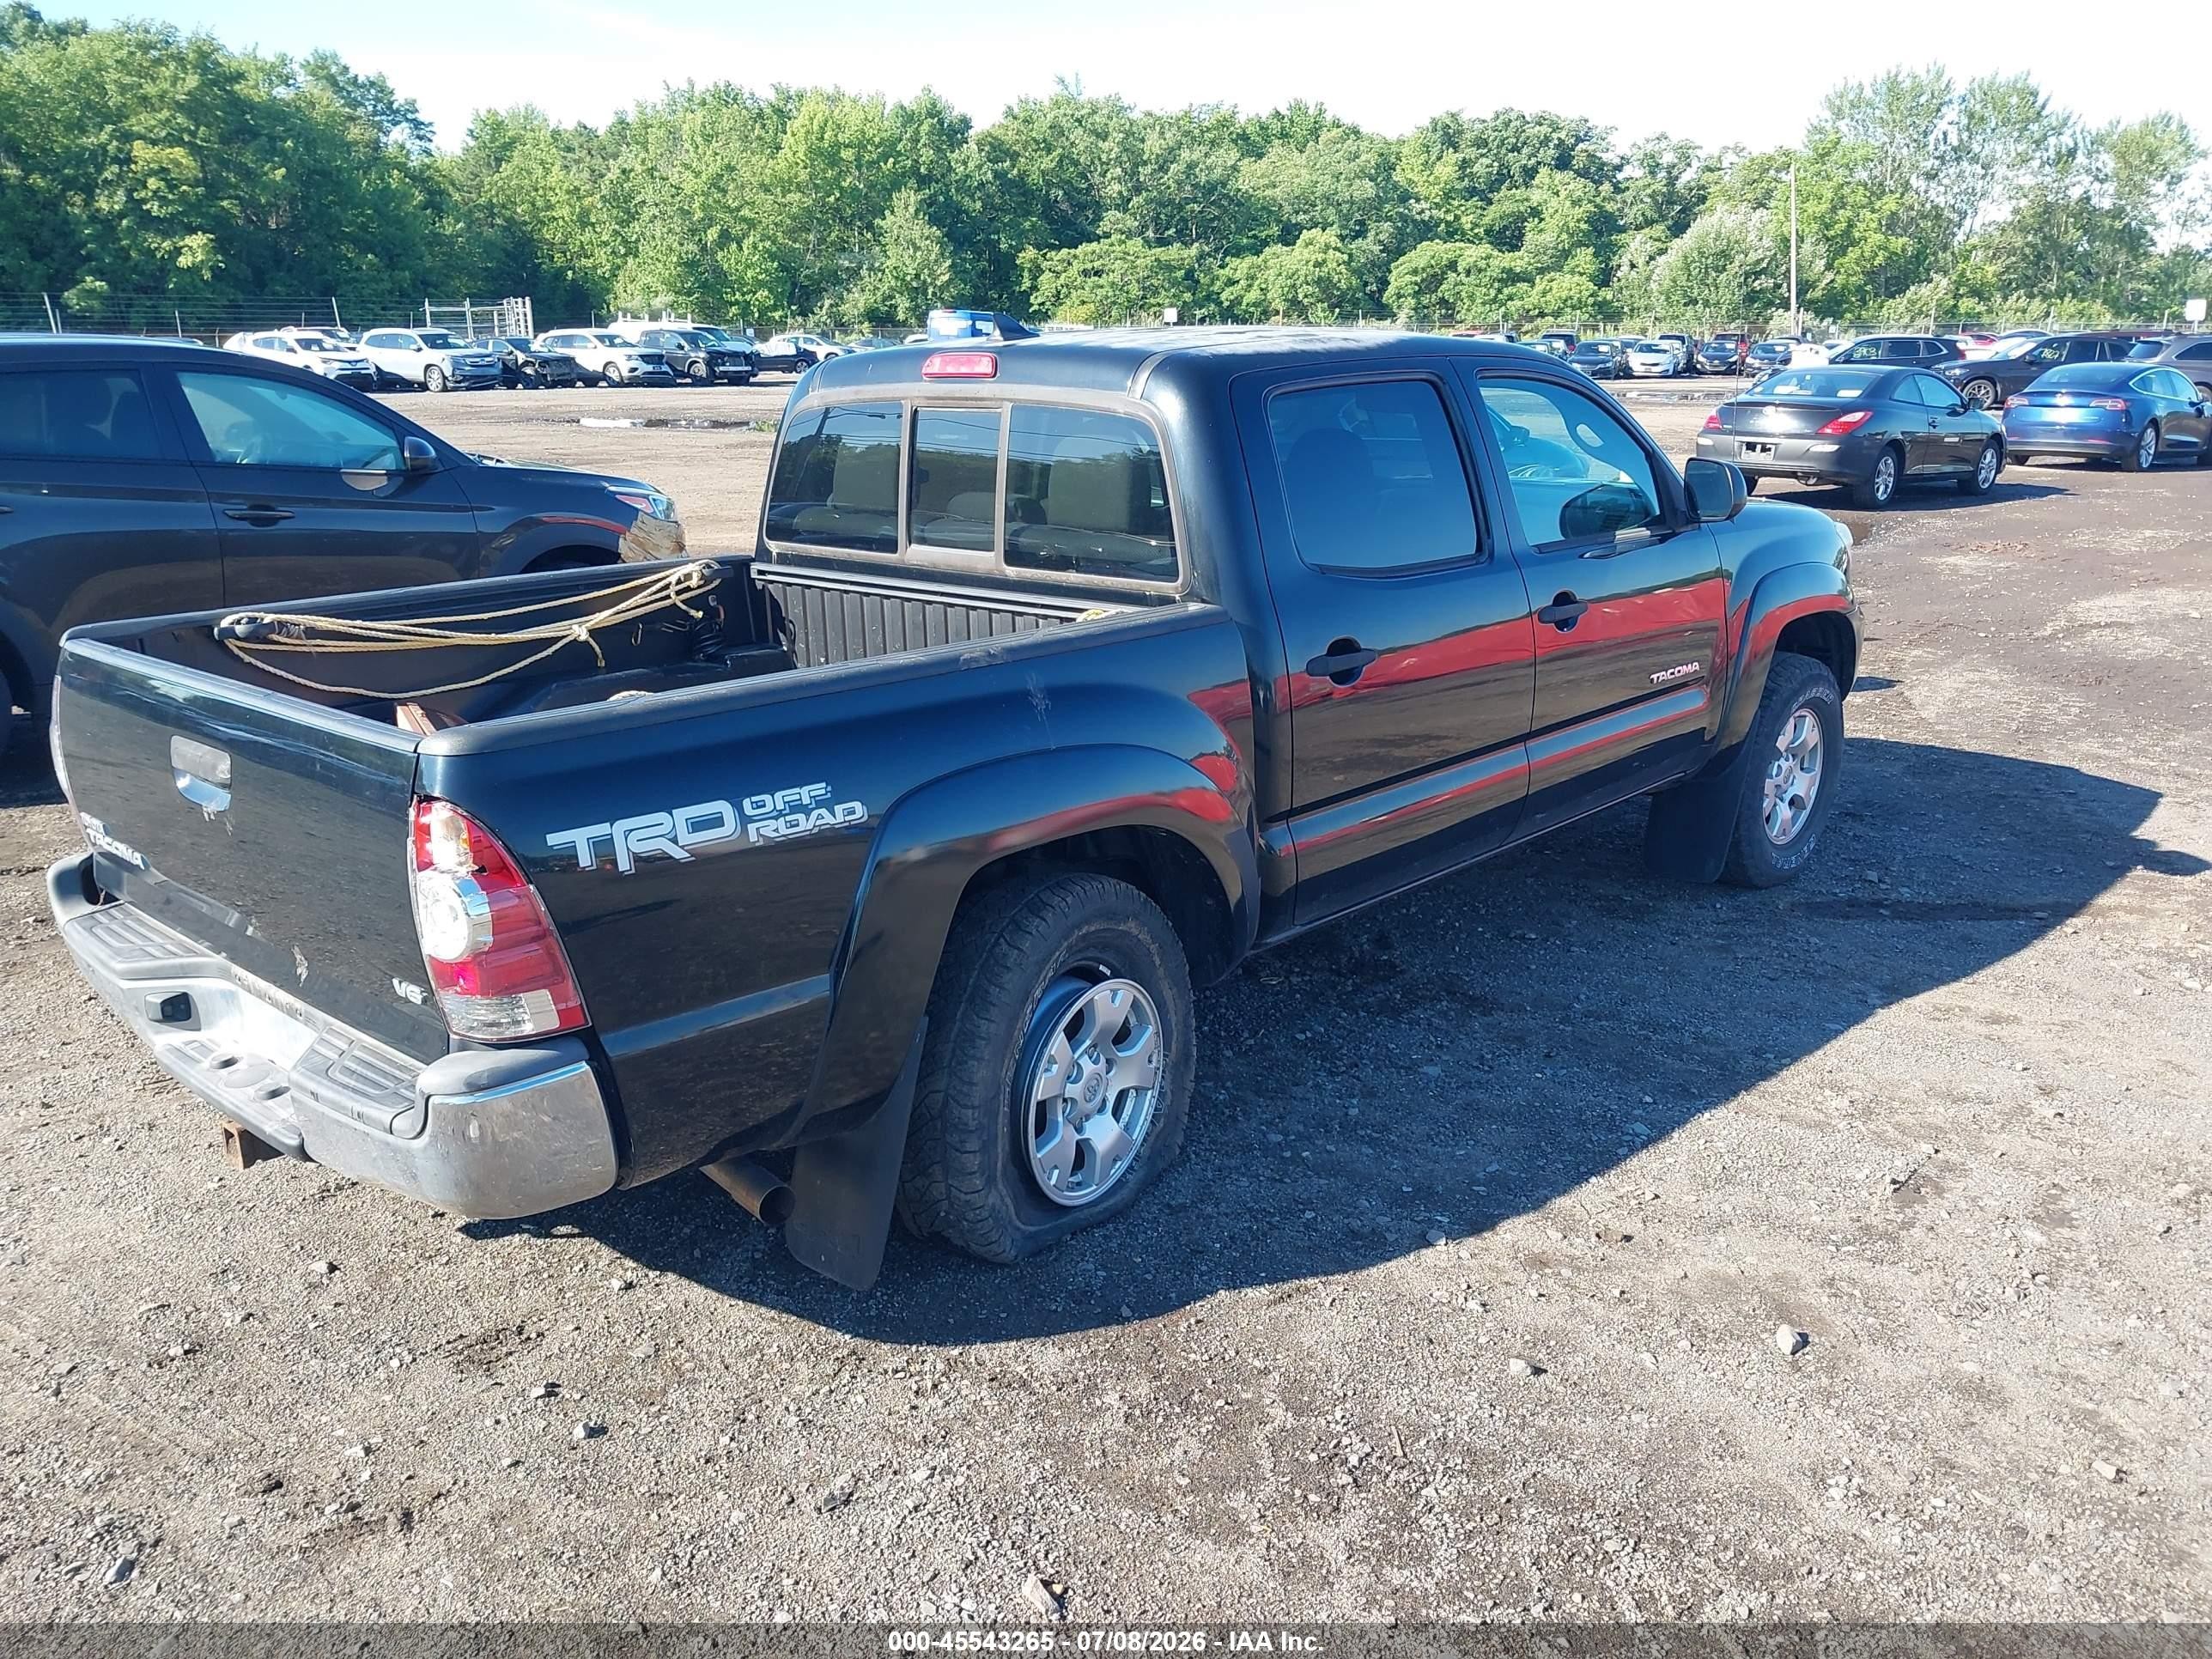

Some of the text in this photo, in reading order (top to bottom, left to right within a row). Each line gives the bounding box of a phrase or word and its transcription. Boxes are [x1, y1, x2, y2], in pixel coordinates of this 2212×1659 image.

[1650, 661, 1700, 684] TACOMA
[742, 782, 831, 819] OFF
[544, 799, 740, 876] TRD
[746, 800, 869, 846] ROAD
[86, 827, 145, 871] TACOMA
[392, 977, 422, 1005] V6
